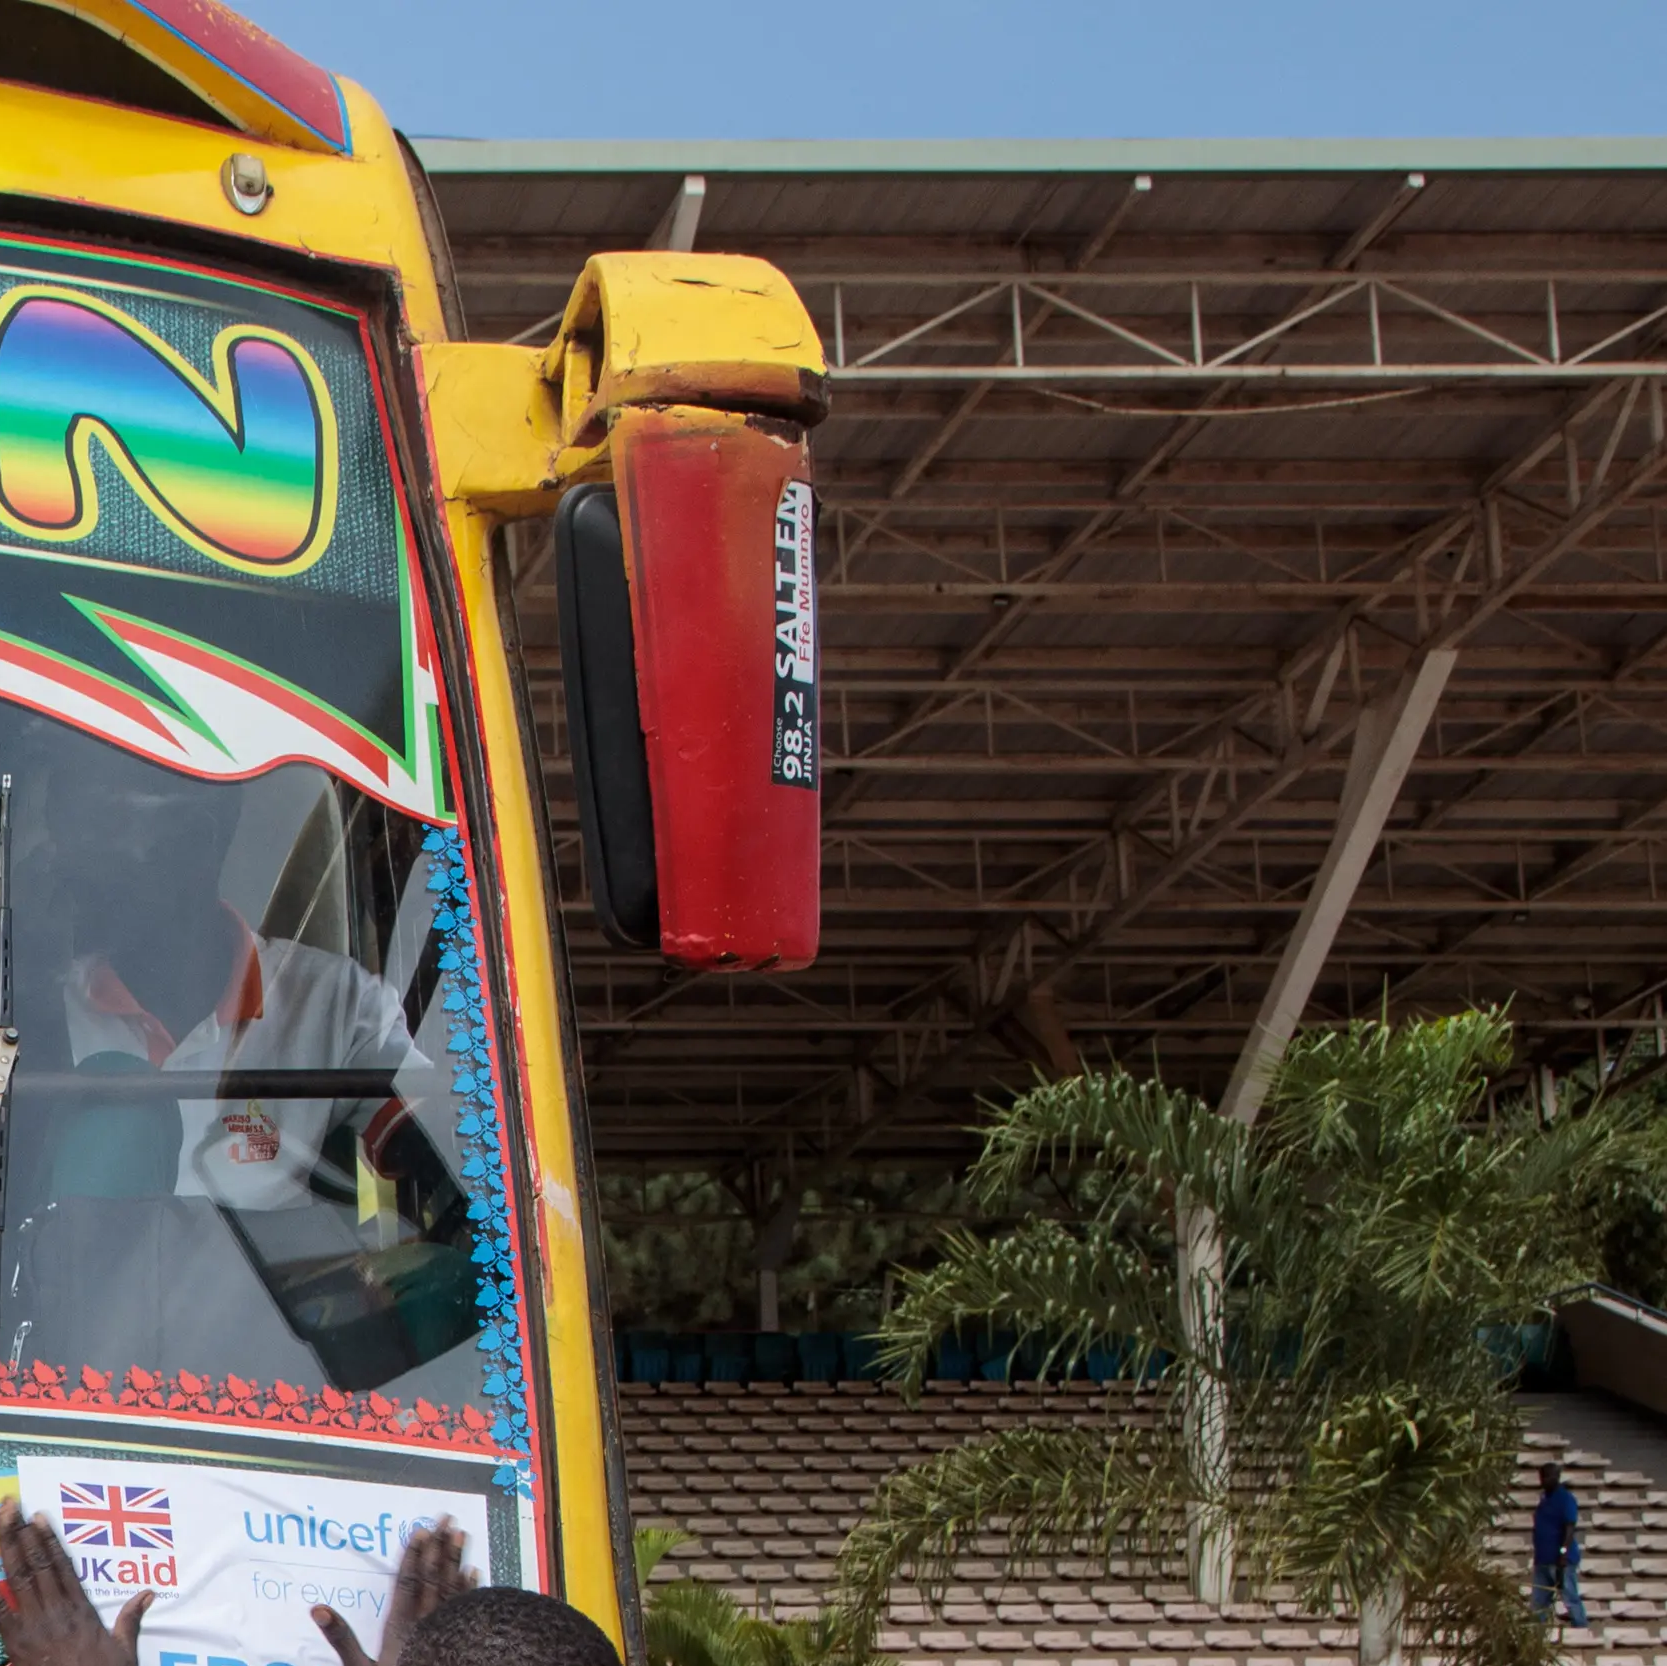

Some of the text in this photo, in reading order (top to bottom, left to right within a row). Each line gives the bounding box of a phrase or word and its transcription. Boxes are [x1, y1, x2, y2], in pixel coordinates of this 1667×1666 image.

[776, 477, 804, 780] 98.2 SALT FM
[798, 503, 813, 782] JINJA Ffe Munnyo
[773, 717, 784, 766] Choose
[243, 1504, 393, 1557] unicef
[252, 1571, 386, 1618] for every
